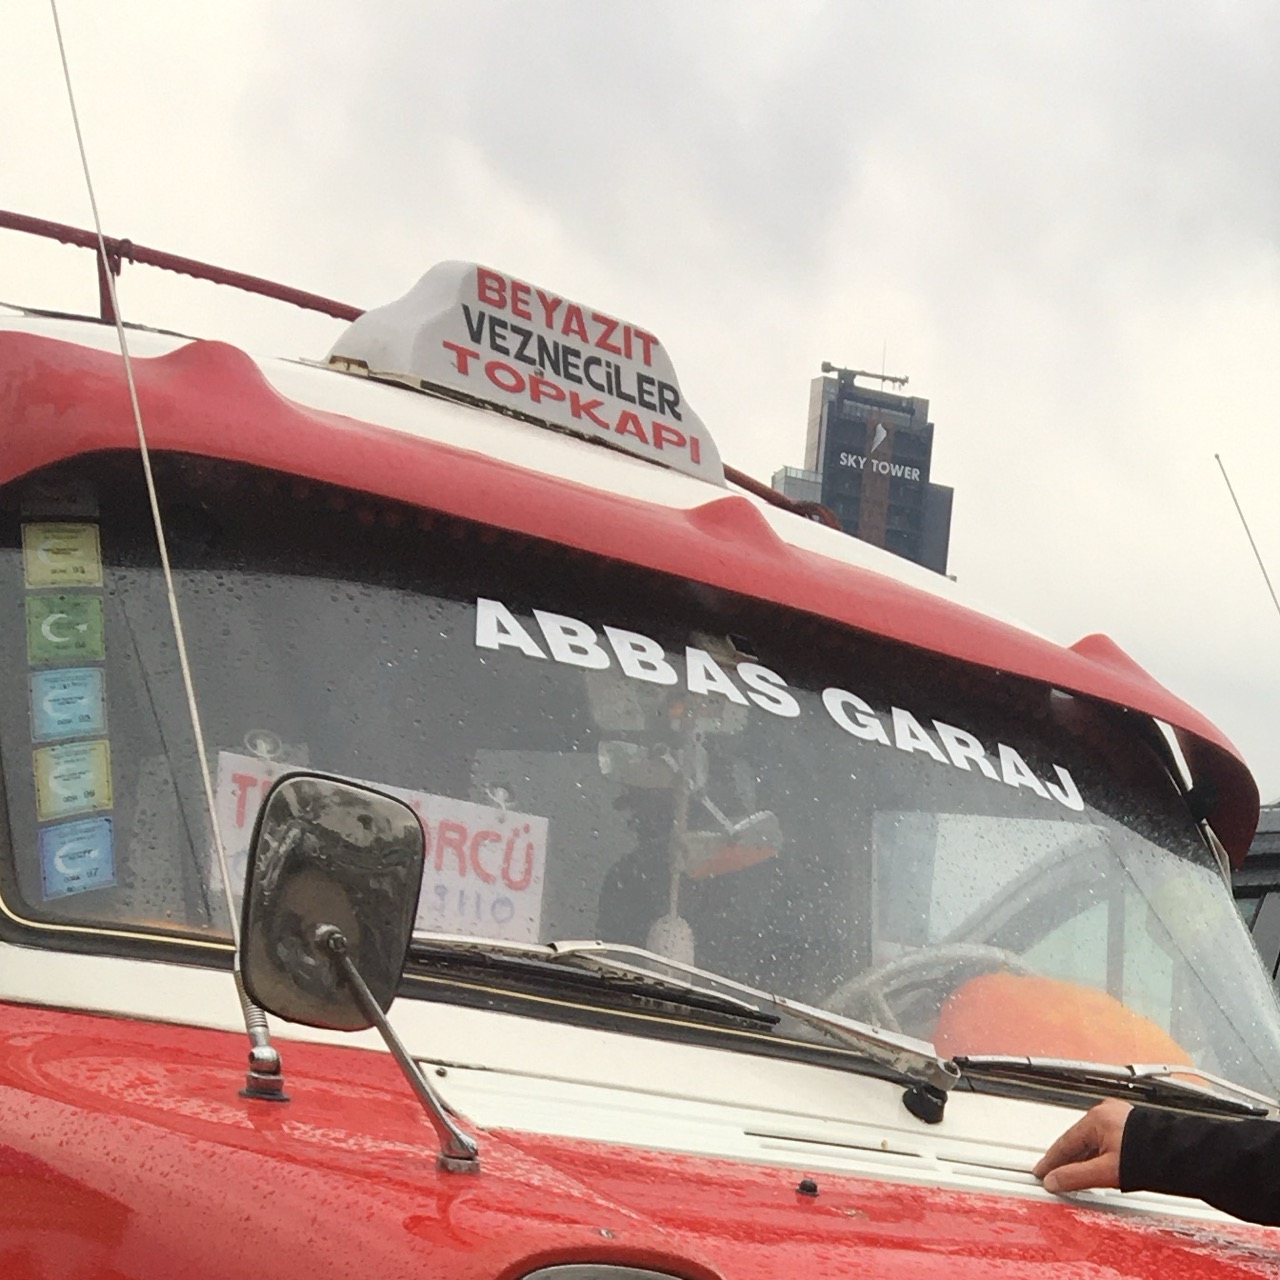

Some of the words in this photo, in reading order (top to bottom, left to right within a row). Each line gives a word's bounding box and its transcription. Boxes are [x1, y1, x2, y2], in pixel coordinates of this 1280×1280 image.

[475, 267, 661, 368] BEYAZIT
[441, 340, 701, 465] TOPKAPI
[839, 452, 867, 470] SKY
[871, 459, 921, 482] TOWER
[475, 597, 801, 718] ABBAS
[821, 687, 1085, 812] GARAJ
